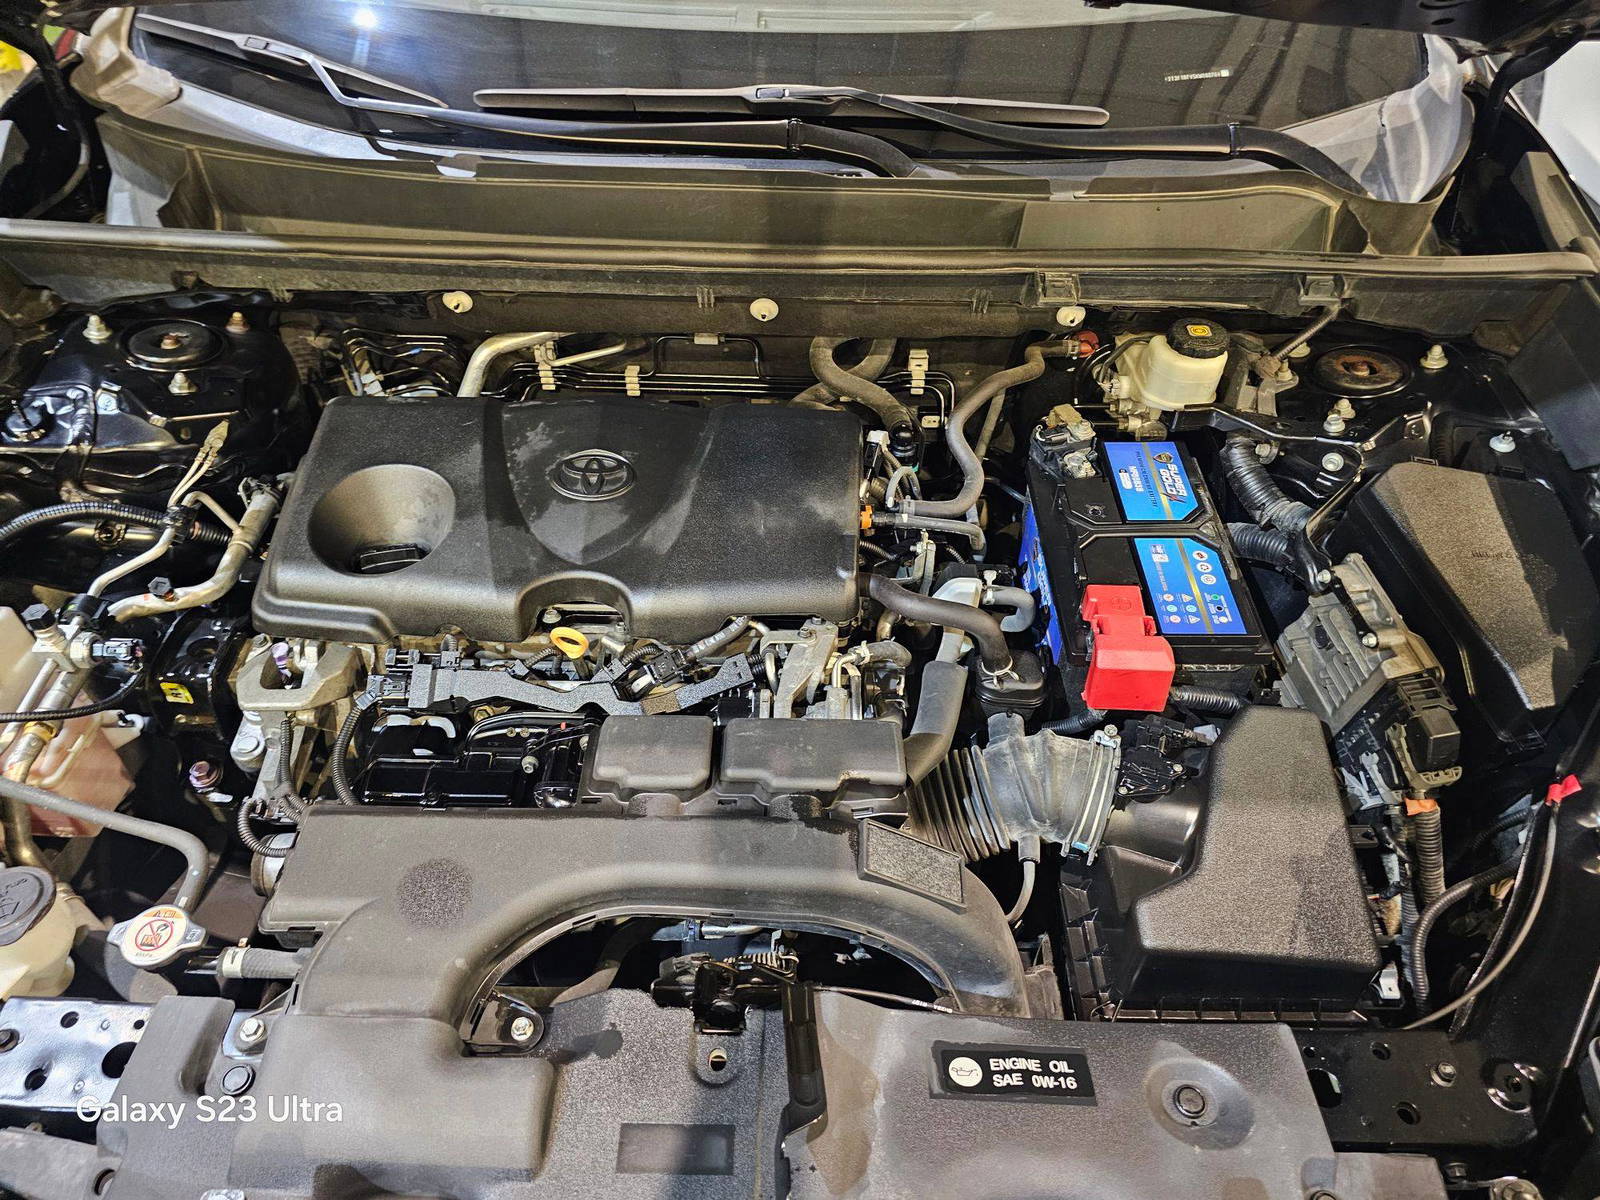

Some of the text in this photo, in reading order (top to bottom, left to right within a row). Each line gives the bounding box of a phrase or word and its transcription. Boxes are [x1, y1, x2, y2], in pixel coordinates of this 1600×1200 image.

[1160, 468, 1177, 495] GOLD
[1167, 463, 1188, 496] SUPER
[989, 1058, 1075, 1074] ENGINE OIL
[992, 1073, 1078, 1090] SAE 0W-16
